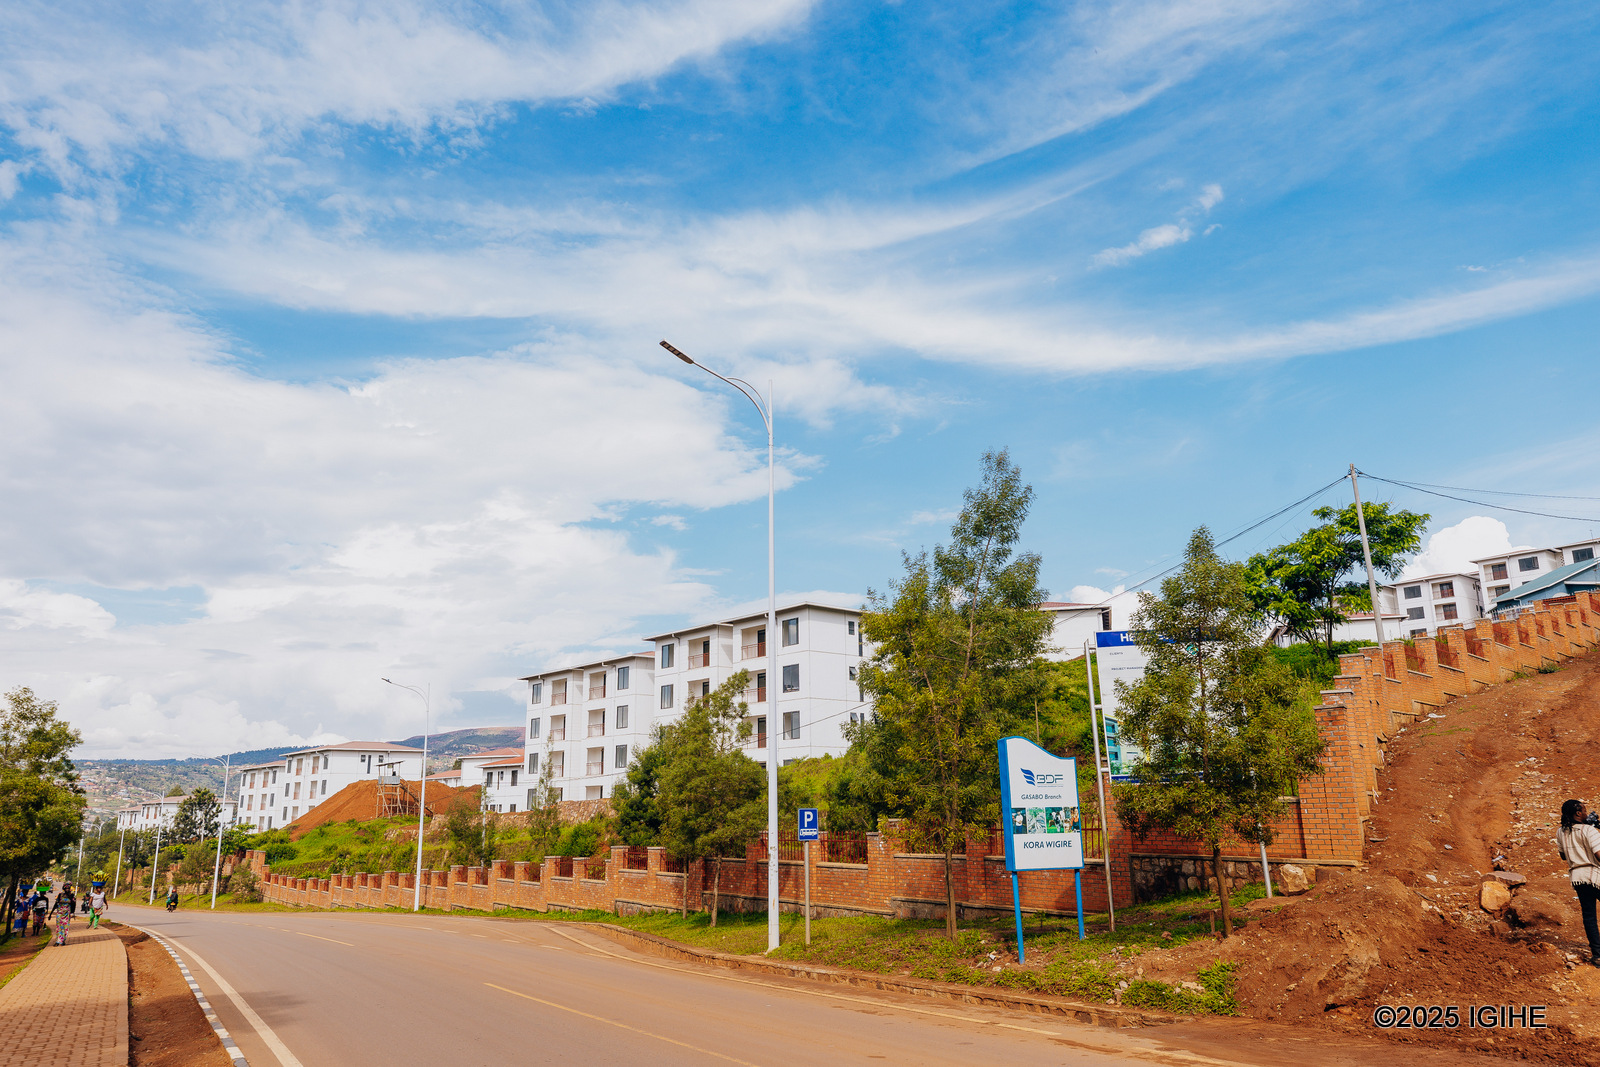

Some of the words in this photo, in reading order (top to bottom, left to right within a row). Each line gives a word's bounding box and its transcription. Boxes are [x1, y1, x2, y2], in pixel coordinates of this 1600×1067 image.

[1036, 774, 1063, 783] BDF
[804, 811, 813, 827] P
[1023, 841, 1045, 849] KORA
[1045, 840, 1072, 848] WIGIRE
